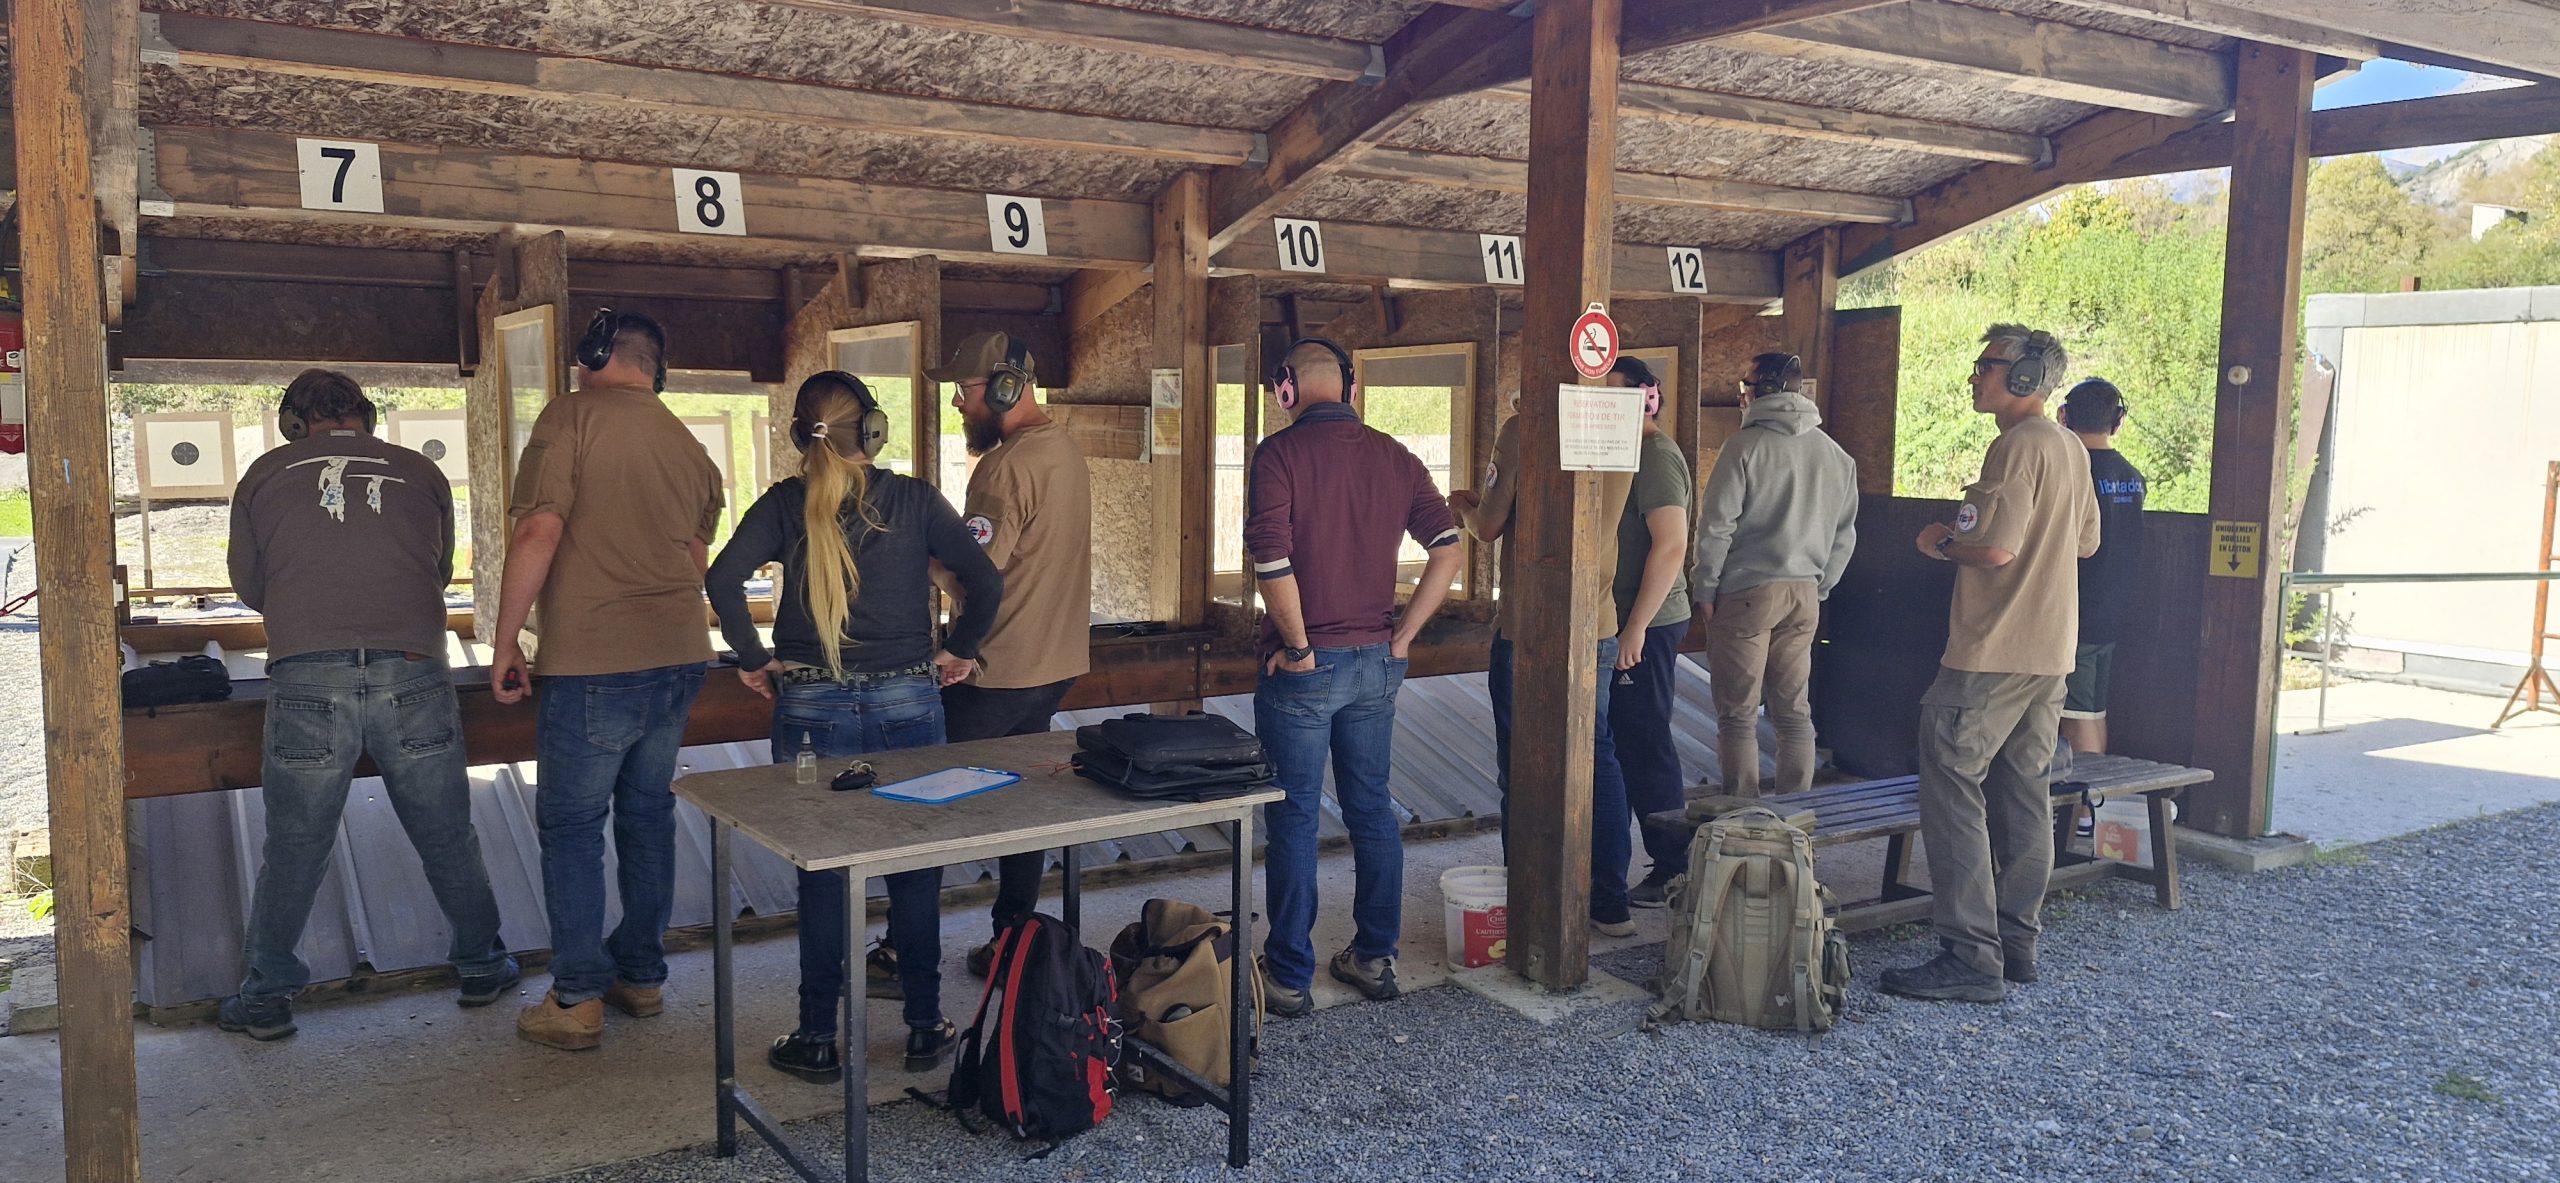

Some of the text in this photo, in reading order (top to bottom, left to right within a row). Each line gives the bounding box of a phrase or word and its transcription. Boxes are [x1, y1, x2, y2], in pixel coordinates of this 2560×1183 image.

[320, 148, 356, 203] 7
[695, 176, 725, 228] 8
[1004, 201, 1030, 249] 9
[1280, 223, 1319, 267] 10
[1488, 239, 1519, 280] 11
[1672, 252, 1704, 289] 12
